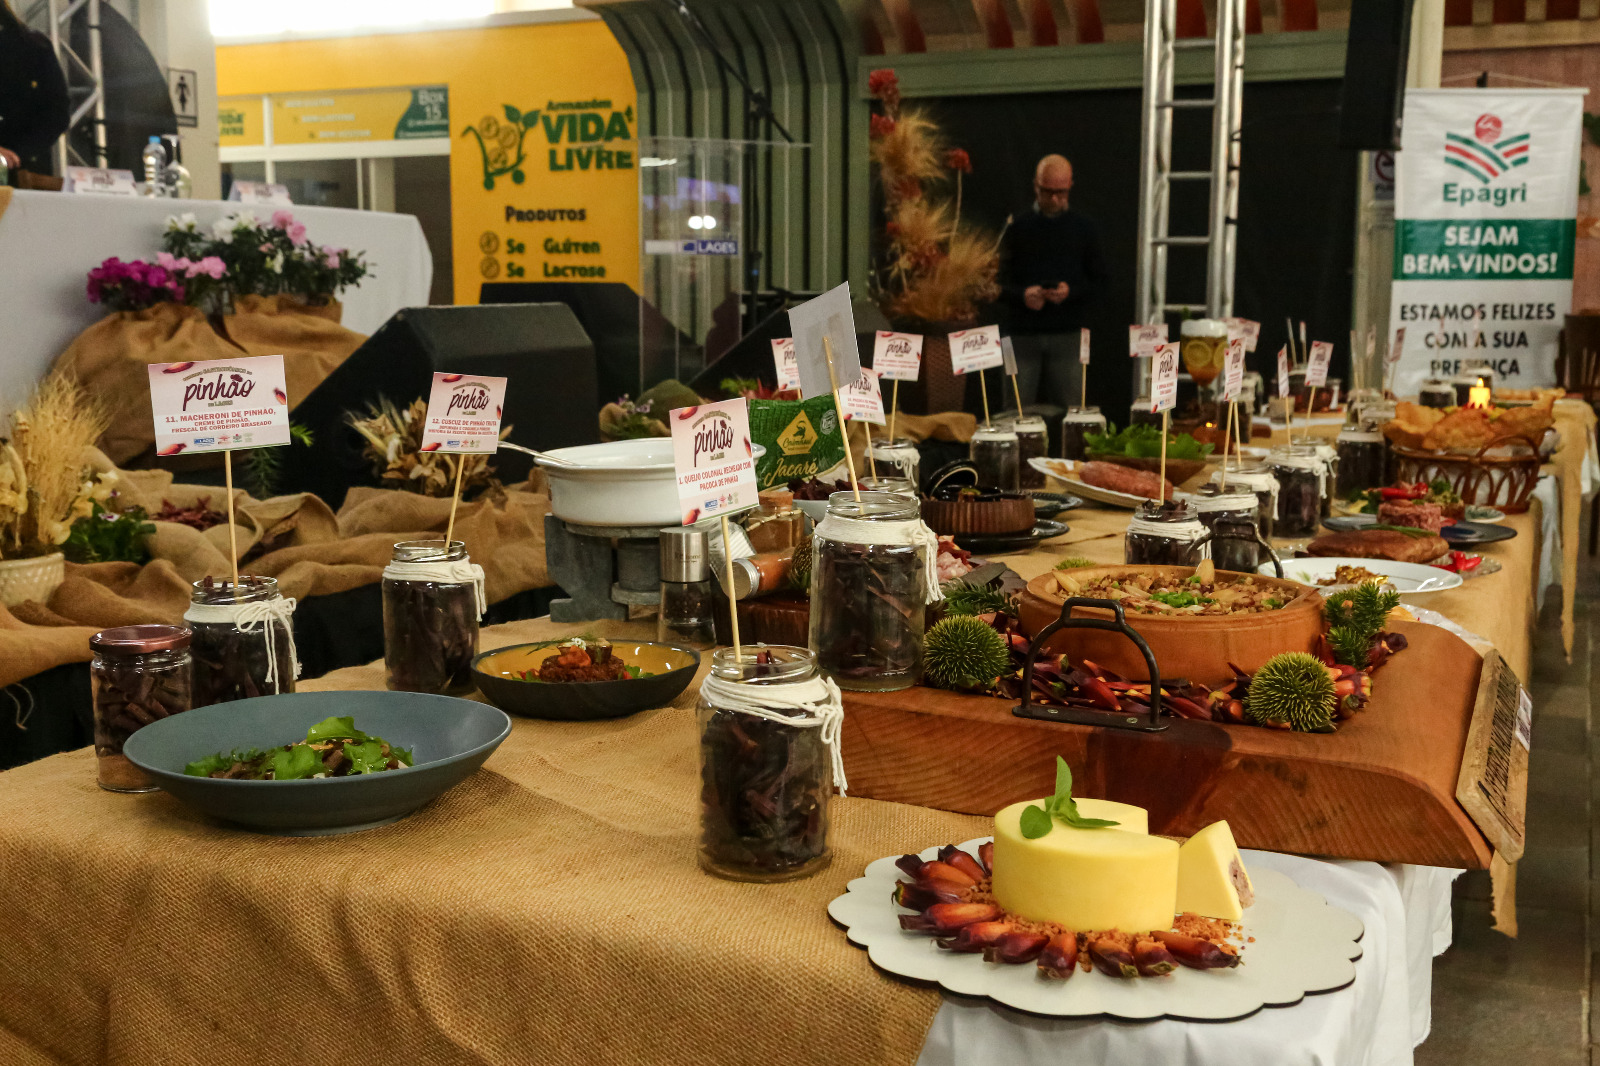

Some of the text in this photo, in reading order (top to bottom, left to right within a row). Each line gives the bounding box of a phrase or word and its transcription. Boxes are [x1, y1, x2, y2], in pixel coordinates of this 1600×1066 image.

[541, 111, 631, 144] VIDA
[549, 147, 634, 171] LIVRE
[1443, 183, 1527, 207] Epagri
[698, 241, 736, 252] LAGES
[1445, 226, 1519, 246] SEJAM
[1402, 252, 1558, 274] BEM-VINDOS!
[1400, 303, 1555, 321] ESTAMOS FELIZES
[1425, 331, 1529, 348] COM A SUA
[183, 374, 256, 411] pinhão
[447, 388, 490, 416] pinhão
[180, 411, 230, 422] MACHERONI
[231, 410, 241, 418] DE
[241, 420, 272, 428] BRASEADO
[694, 419, 735, 467] pinhão
[701, 468, 723, 480] COLONIAL
[717, 478, 724, 487] DE
[764, 457, 820, 487] Jacaré
